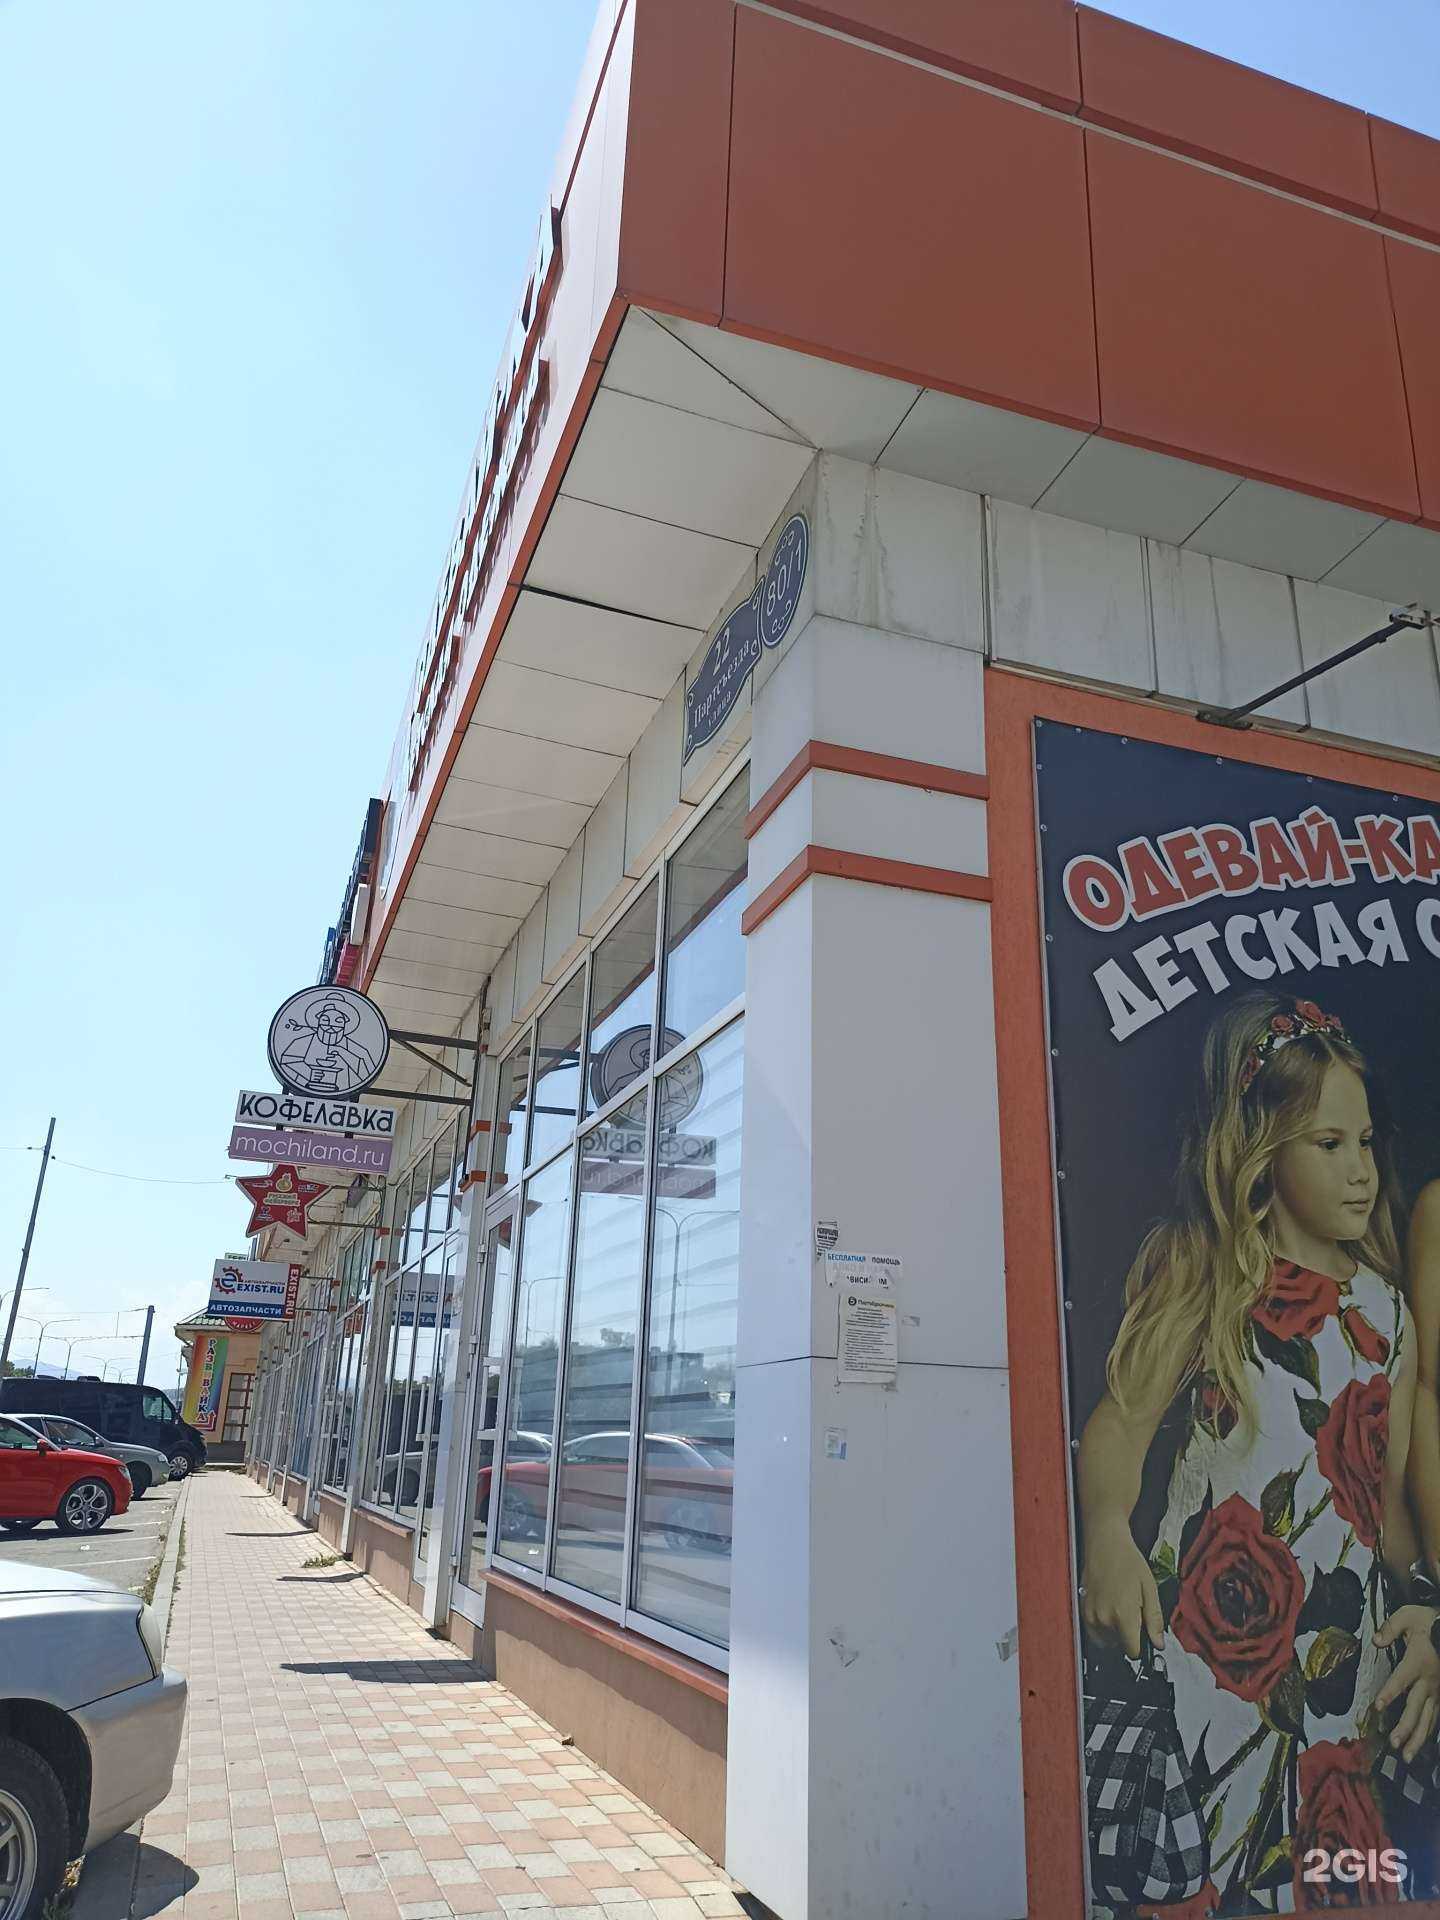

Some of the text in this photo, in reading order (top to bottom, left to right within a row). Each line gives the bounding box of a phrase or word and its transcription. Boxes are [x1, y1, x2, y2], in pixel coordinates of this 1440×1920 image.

[767, 539, 802, 617] 80/1
[712, 626, 731, 676] 22
[694, 640, 750, 728] Партсъезда
[1093, 899, 1410, 1042] ДЕТСКАЯ
[239, 1093, 394, 1133] КОФЕЛАВКА
[235, 1135, 385, 1167] mochiland.ru
[872, 1256, 901, 1266] ПОМОЩЬ
[210, 1304, 282, 1315] АВТОЗАПЧАСТИ
[236, 1283, 285, 1294] EXIST.RU
[285, 1268, 299, 1315] EXIST.RU
